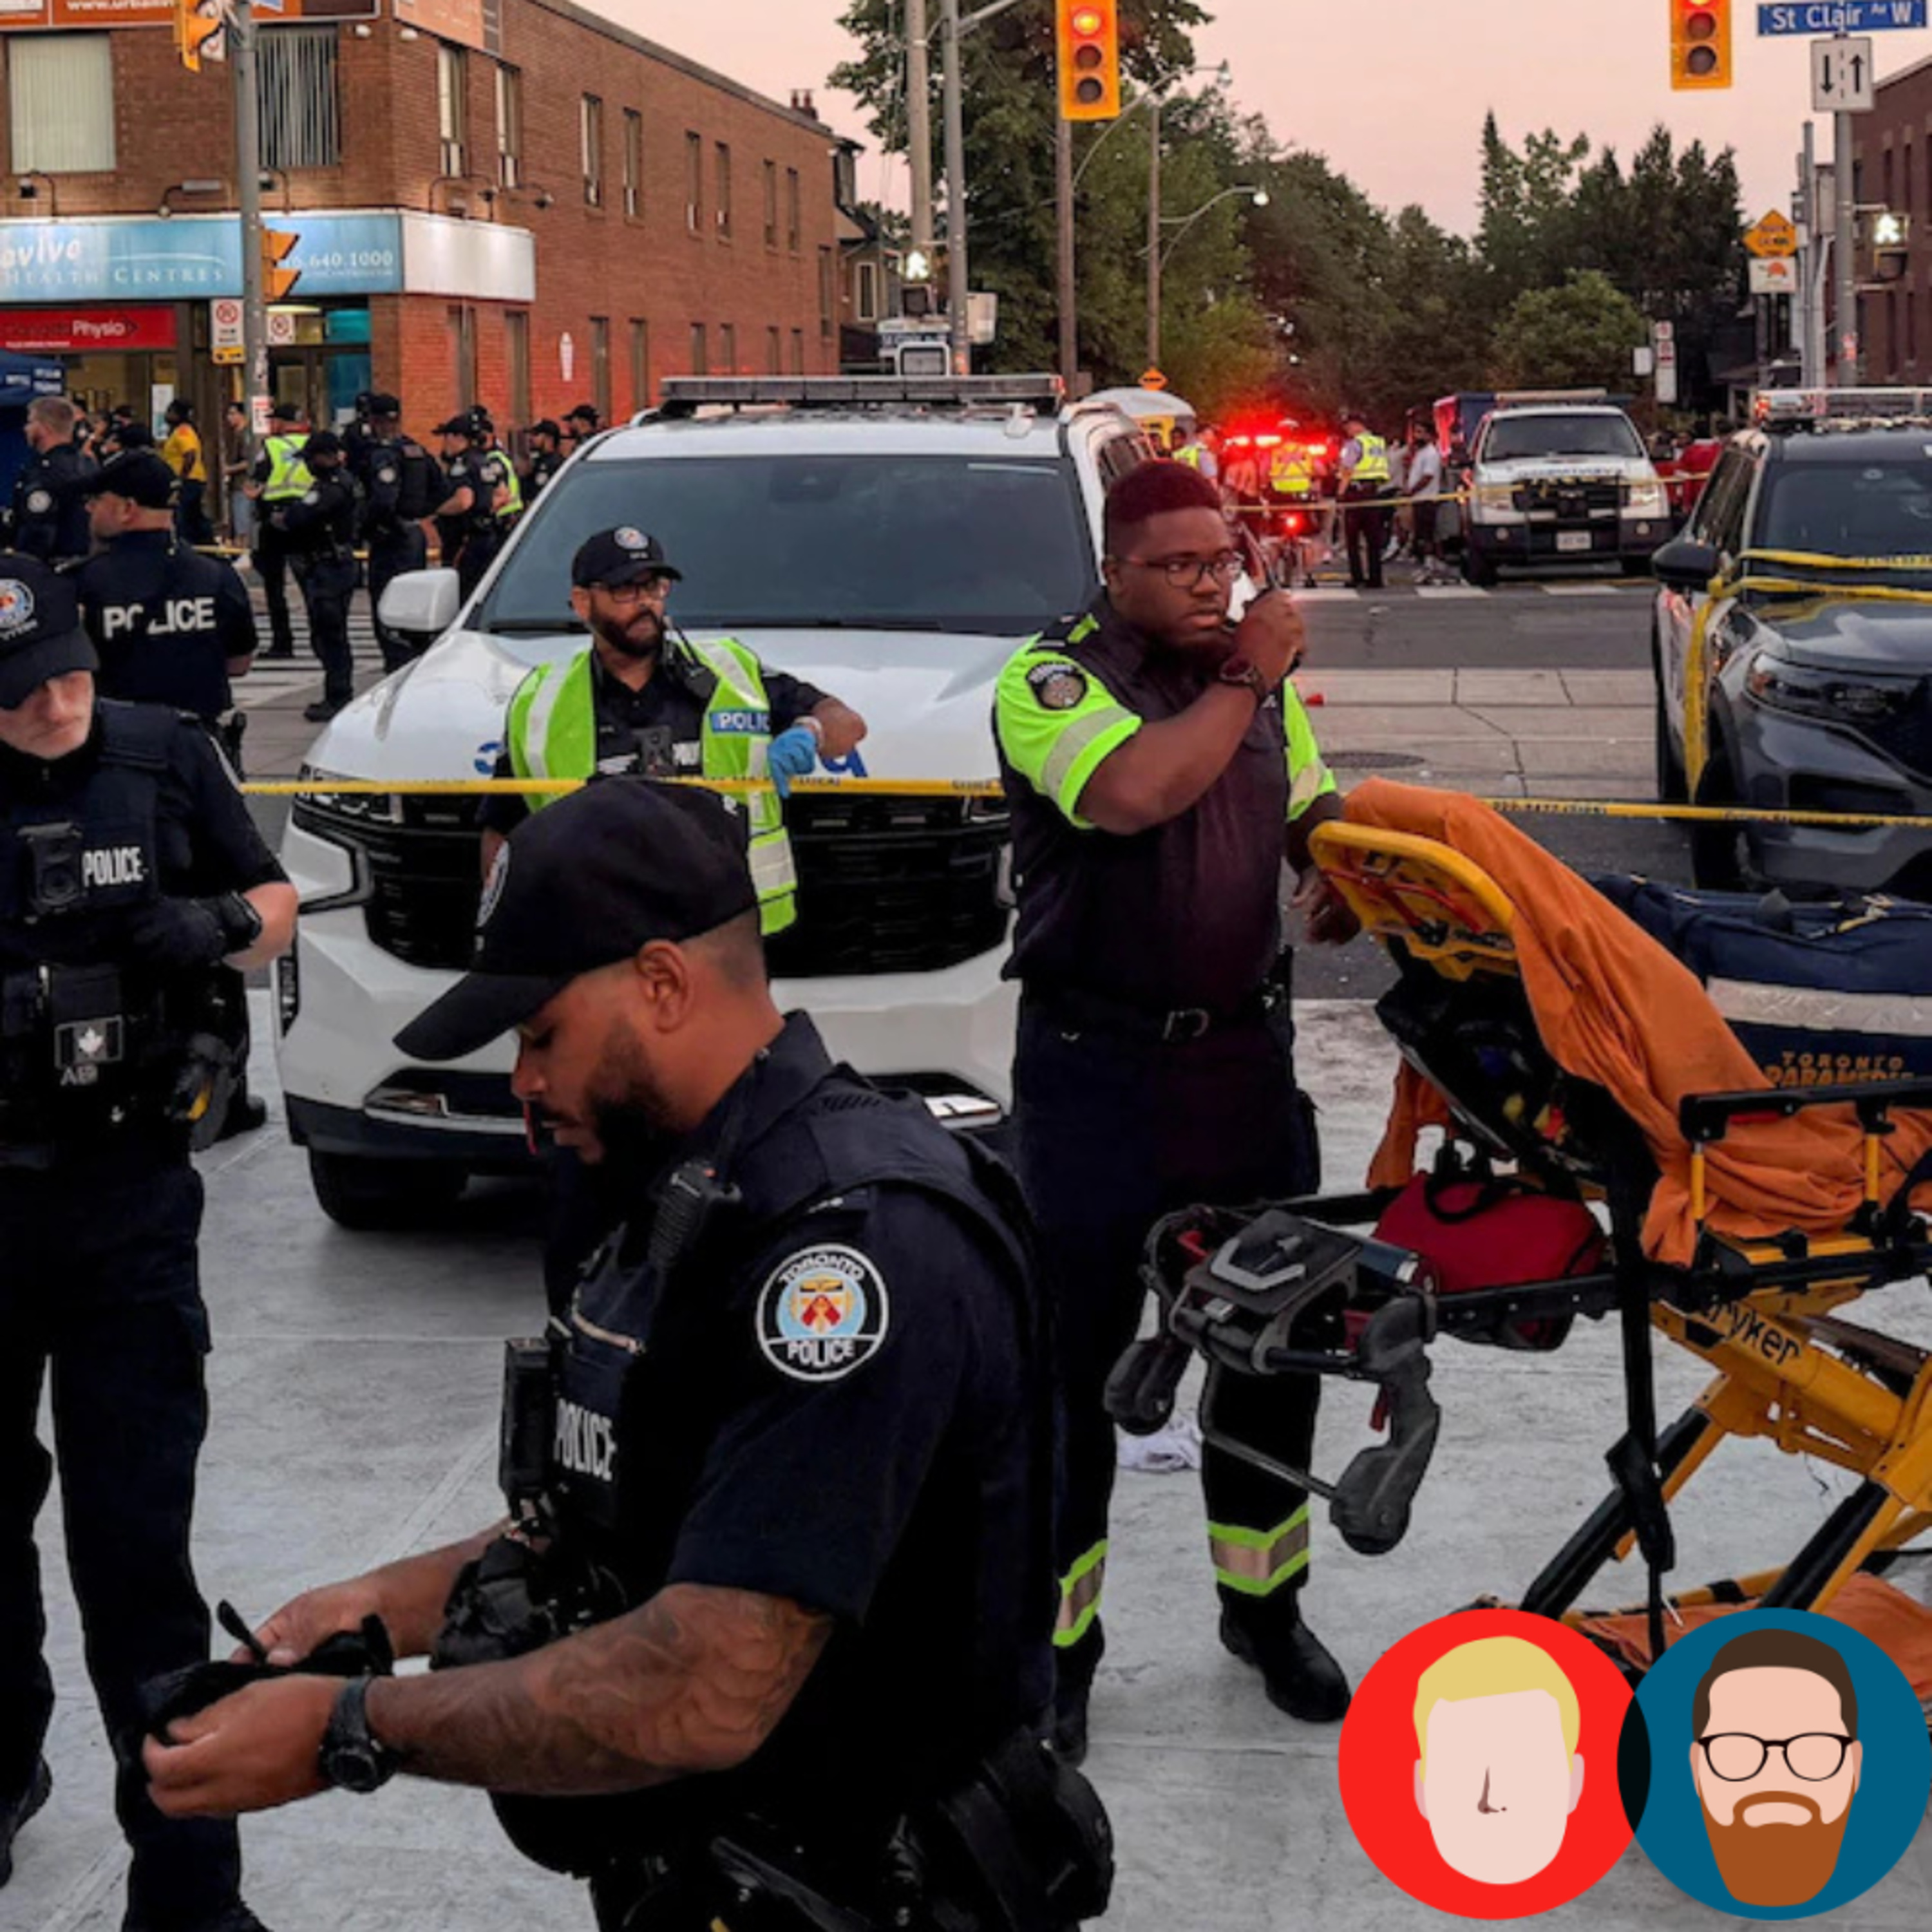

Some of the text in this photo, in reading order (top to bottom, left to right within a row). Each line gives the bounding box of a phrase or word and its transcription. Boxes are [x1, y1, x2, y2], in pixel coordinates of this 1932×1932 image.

[1772, 6, 1796, 30] St
[1806, 5, 1862, 28] Clair
[1891, 2, 1912, 23] W
[115, 266, 224, 284] CENTRES
[72, 319, 126, 339] Physio
[82, 846, 144, 887] POLICE
[1782, 1050, 1904, 1070] TORONTO
[777, 1253, 865, 1283] TORONTO
[787, 1339, 855, 1368] POLICE
[553, 1396, 617, 1481] POLICE
